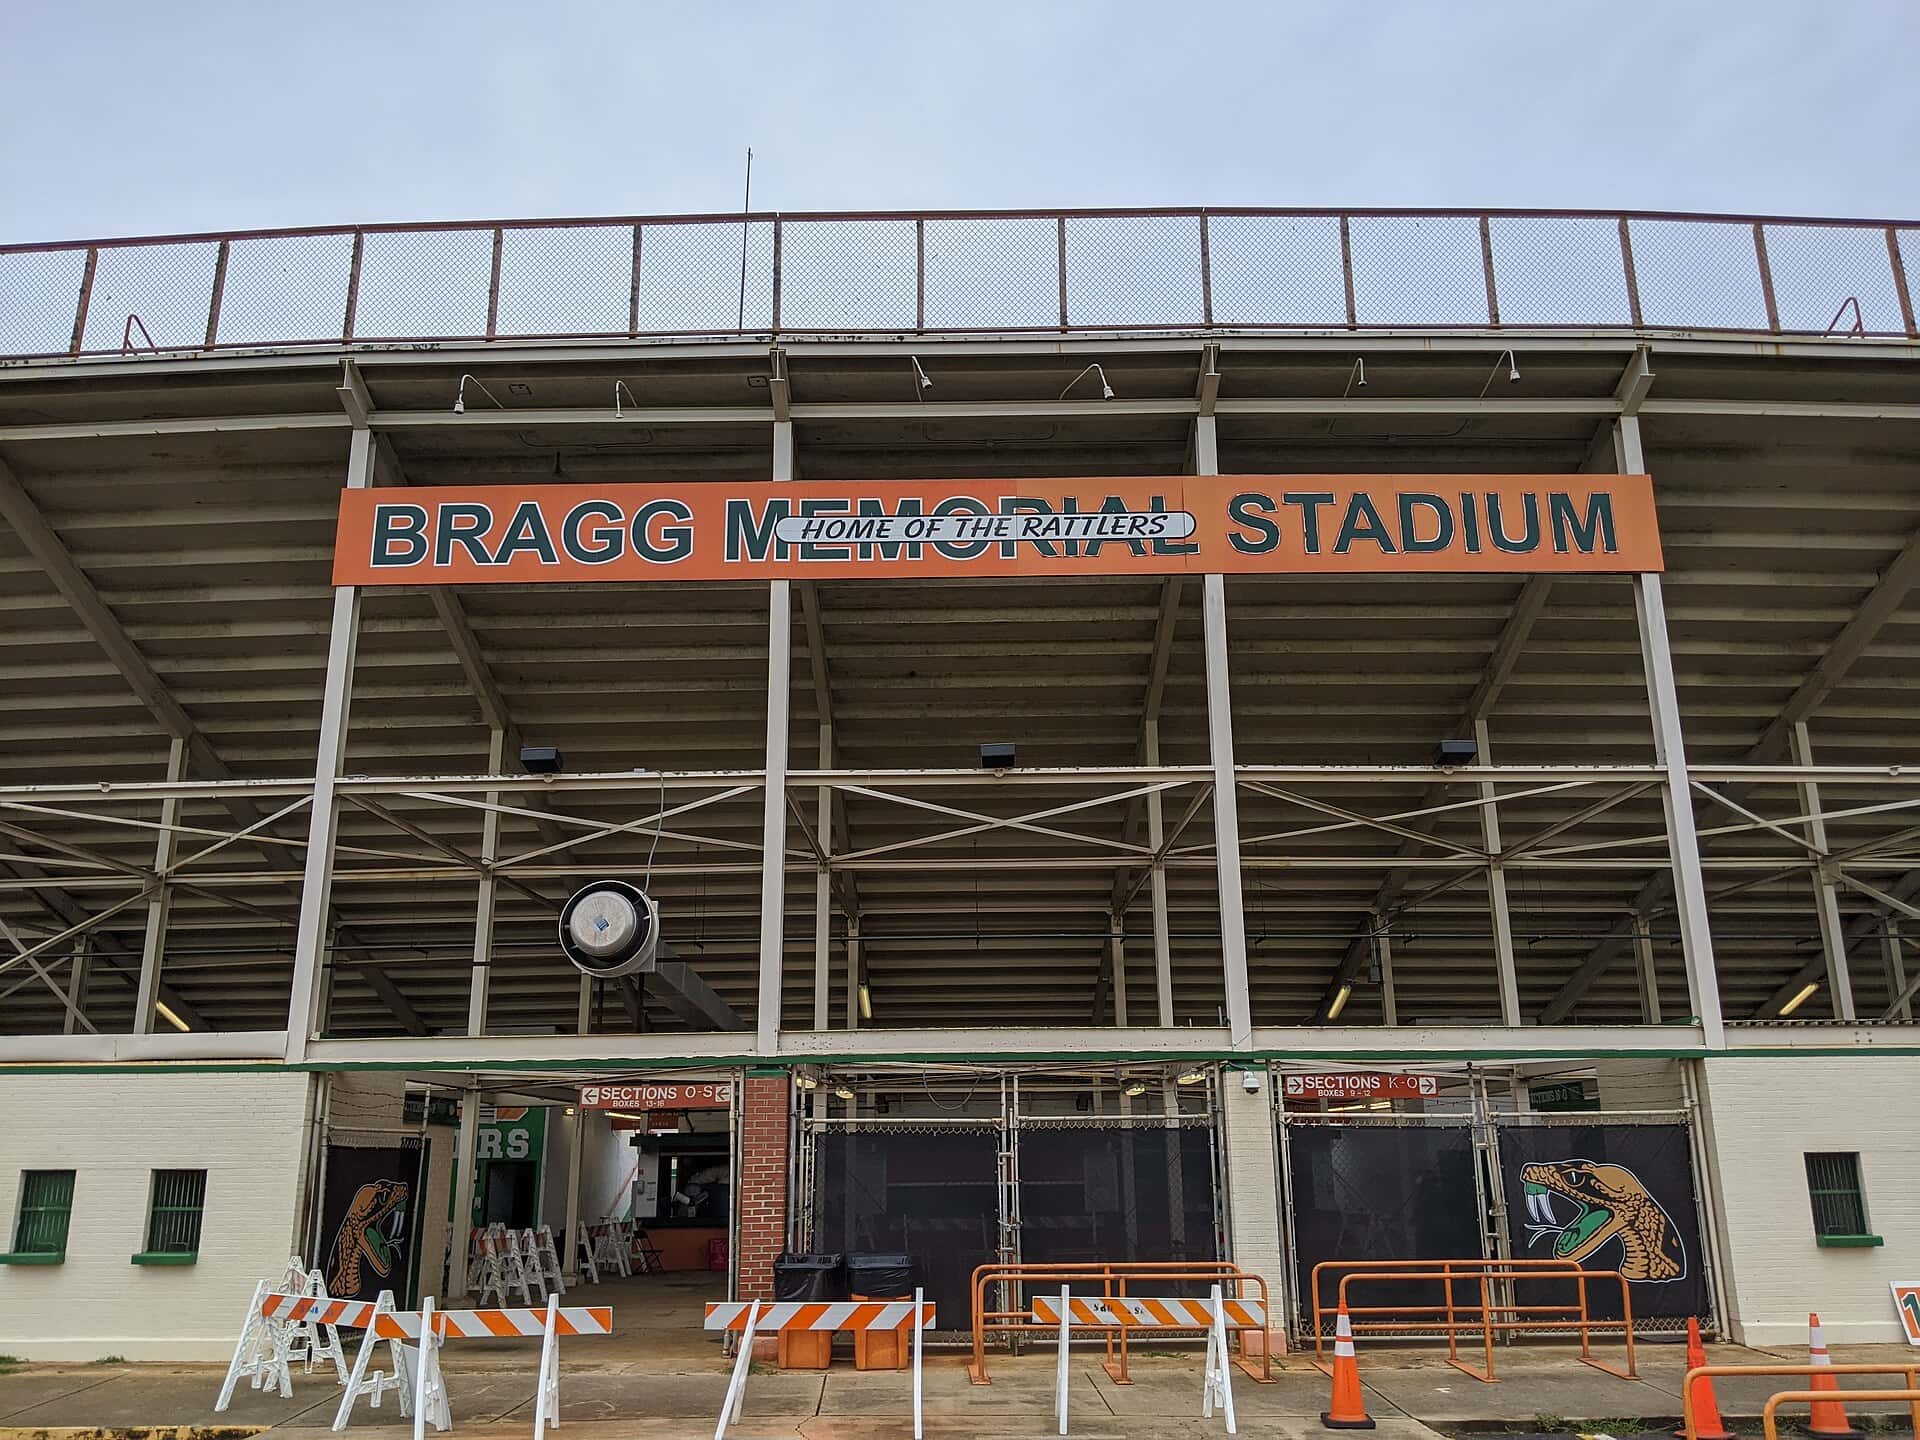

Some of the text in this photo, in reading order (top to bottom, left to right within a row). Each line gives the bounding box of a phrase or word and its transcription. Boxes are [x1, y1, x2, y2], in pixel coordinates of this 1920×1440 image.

[370, 498, 695, 568] BRAGG
[1227, 491, 1619, 555] STADIUM
[801, 515, 1168, 540] HOME OF THE RATTLERS
[1304, 1077, 1418, 1089] SECTIONS K-O
[600, 1085, 713, 1100] SECTIONS O-S
[1317, 1089, 1345, 1097] BOXES
[612, 1100, 640, 1108] BOXES
[452, 1128, 529, 1159] RS
